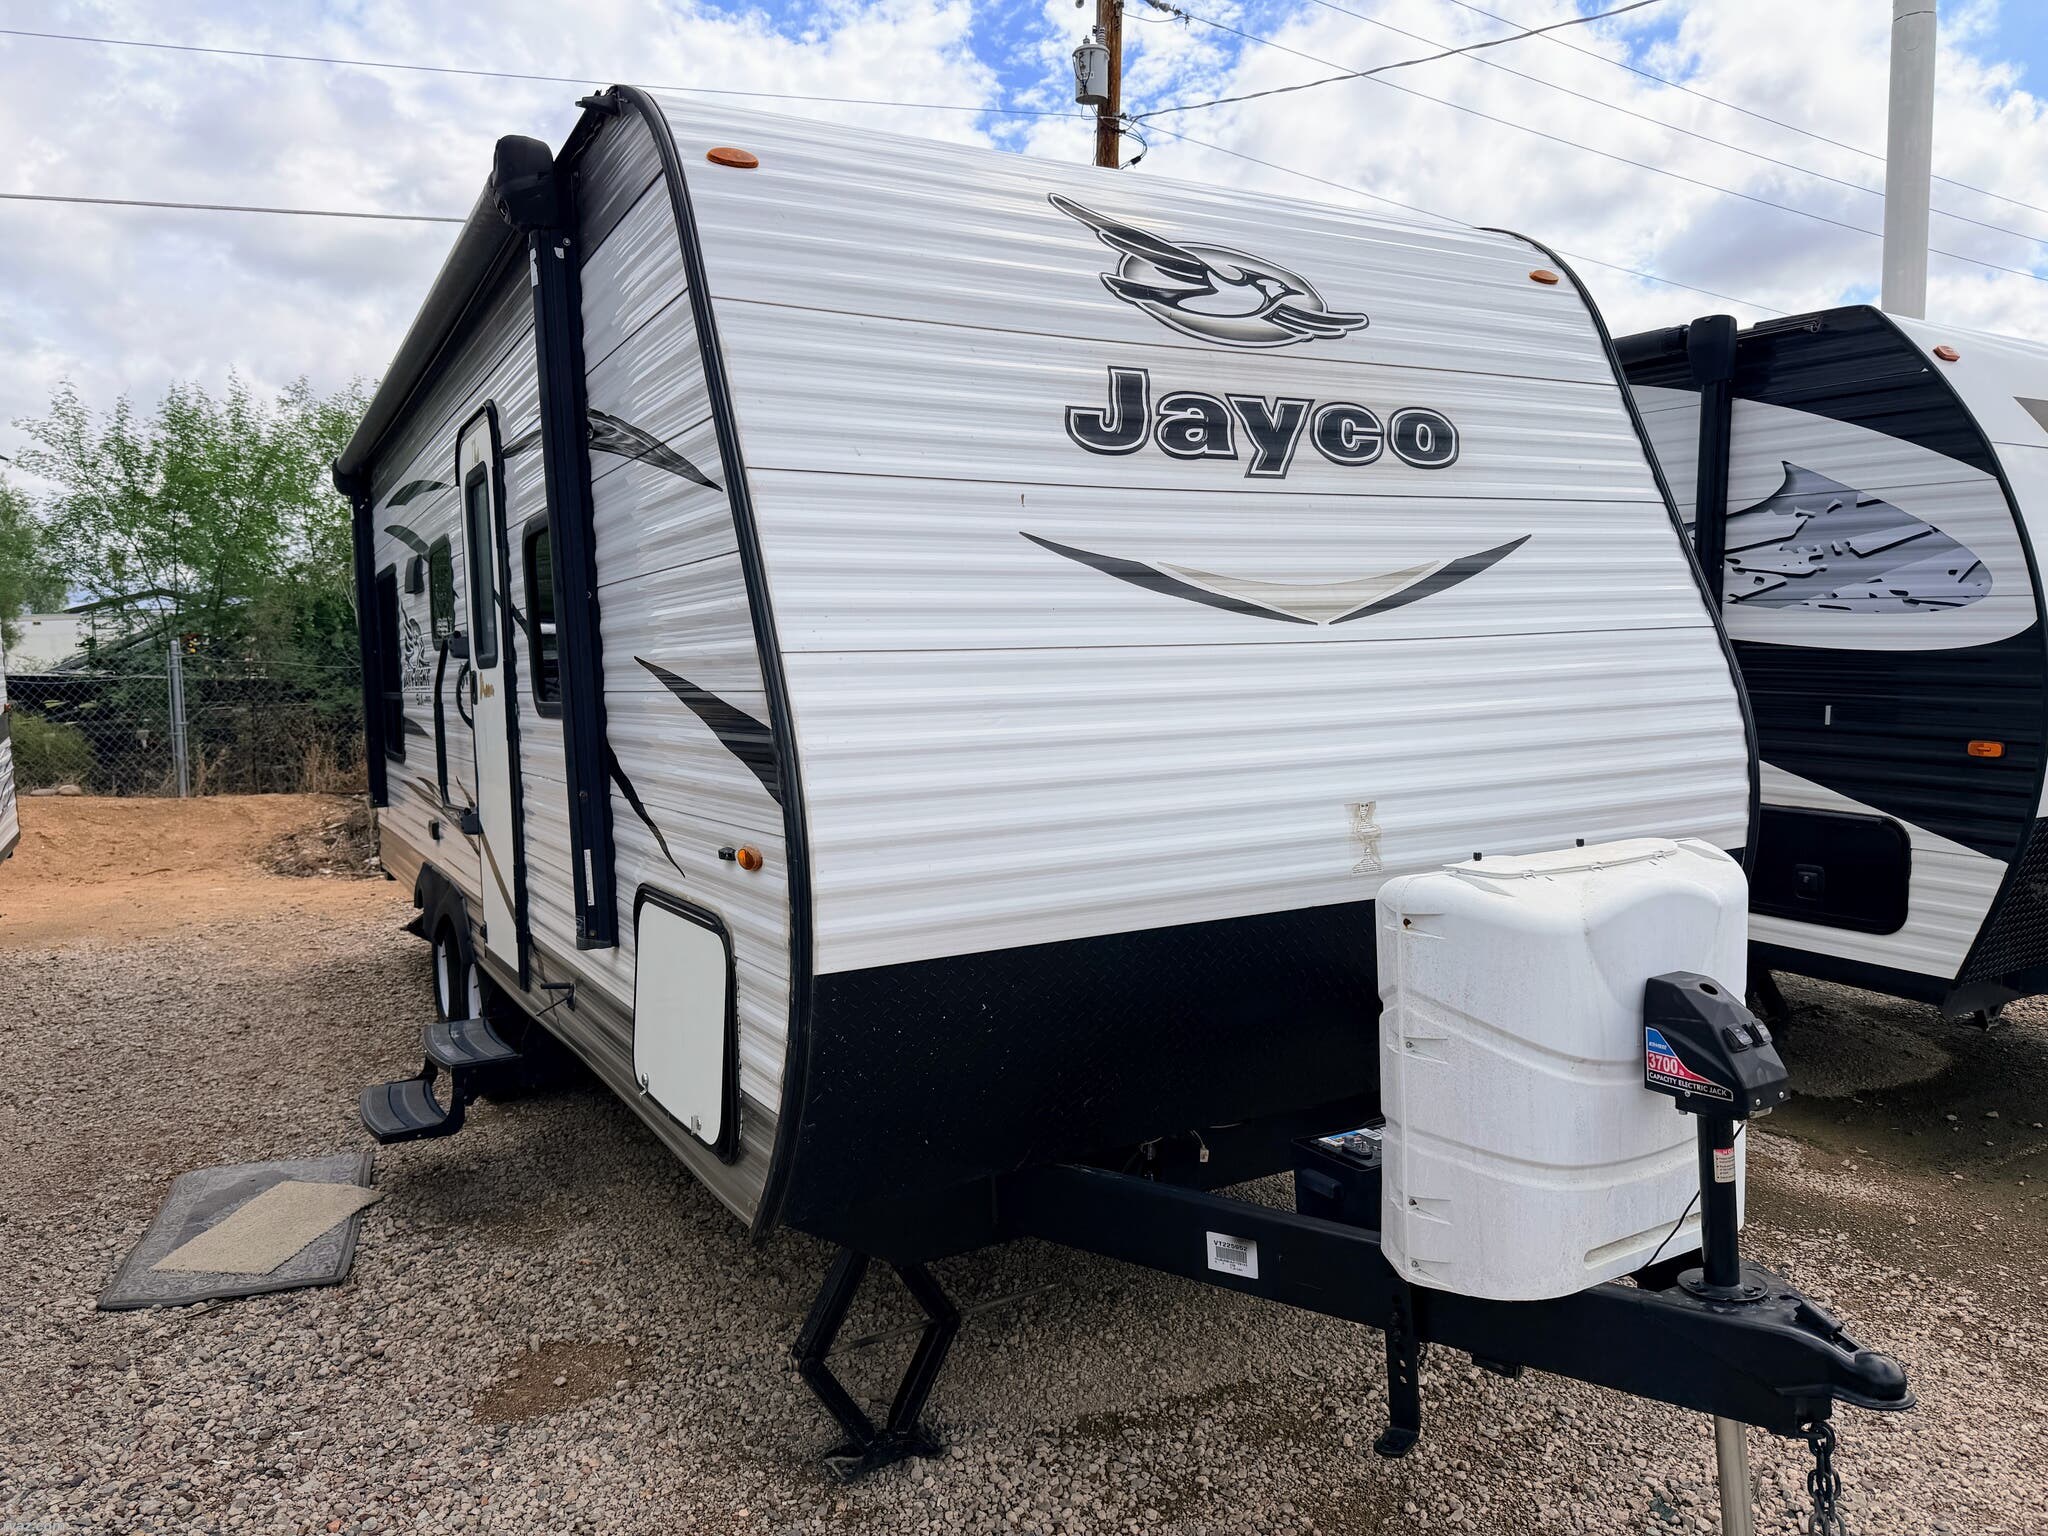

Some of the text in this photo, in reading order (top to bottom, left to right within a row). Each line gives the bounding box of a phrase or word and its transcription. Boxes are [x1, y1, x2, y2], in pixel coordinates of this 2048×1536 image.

[1065, 366, 1459, 479] Jayco
[1648, 1053, 1679, 1075] 3700
[1649, 1072, 1728, 1097] CAPACITY ELECTRIC JACK
